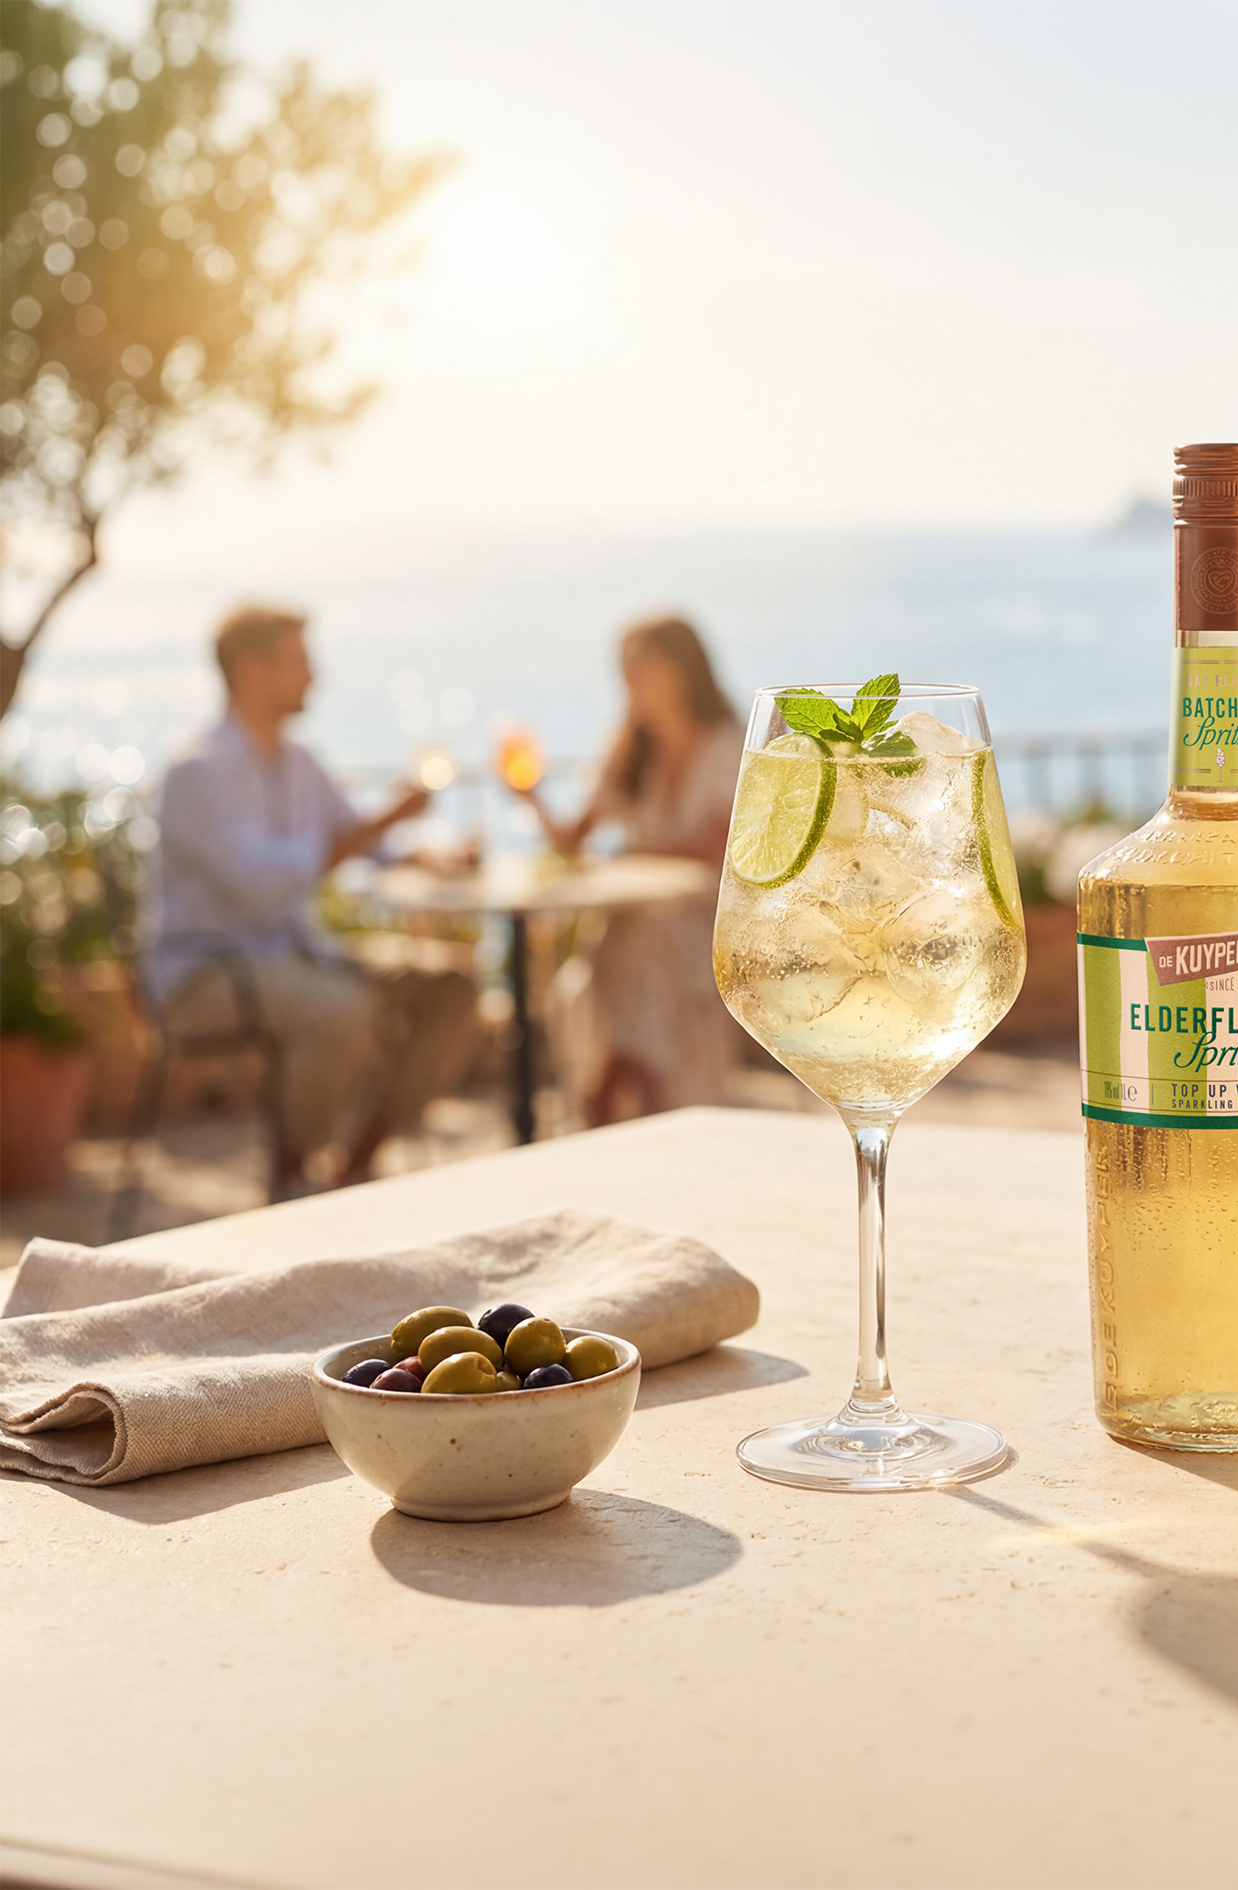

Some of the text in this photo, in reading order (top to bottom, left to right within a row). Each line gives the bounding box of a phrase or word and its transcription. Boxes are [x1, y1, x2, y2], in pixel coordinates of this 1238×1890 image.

[1186, 674, 1209, 687] BAR
[1159, 956, 1173, 968] DE
[1209, 976, 1235, 991] SINCE
[1171, 1083, 1199, 1097] TOP
[1208, 1084, 1227, 1098] UP
[1171, 1099, 1233, 1109] SPARKLING
